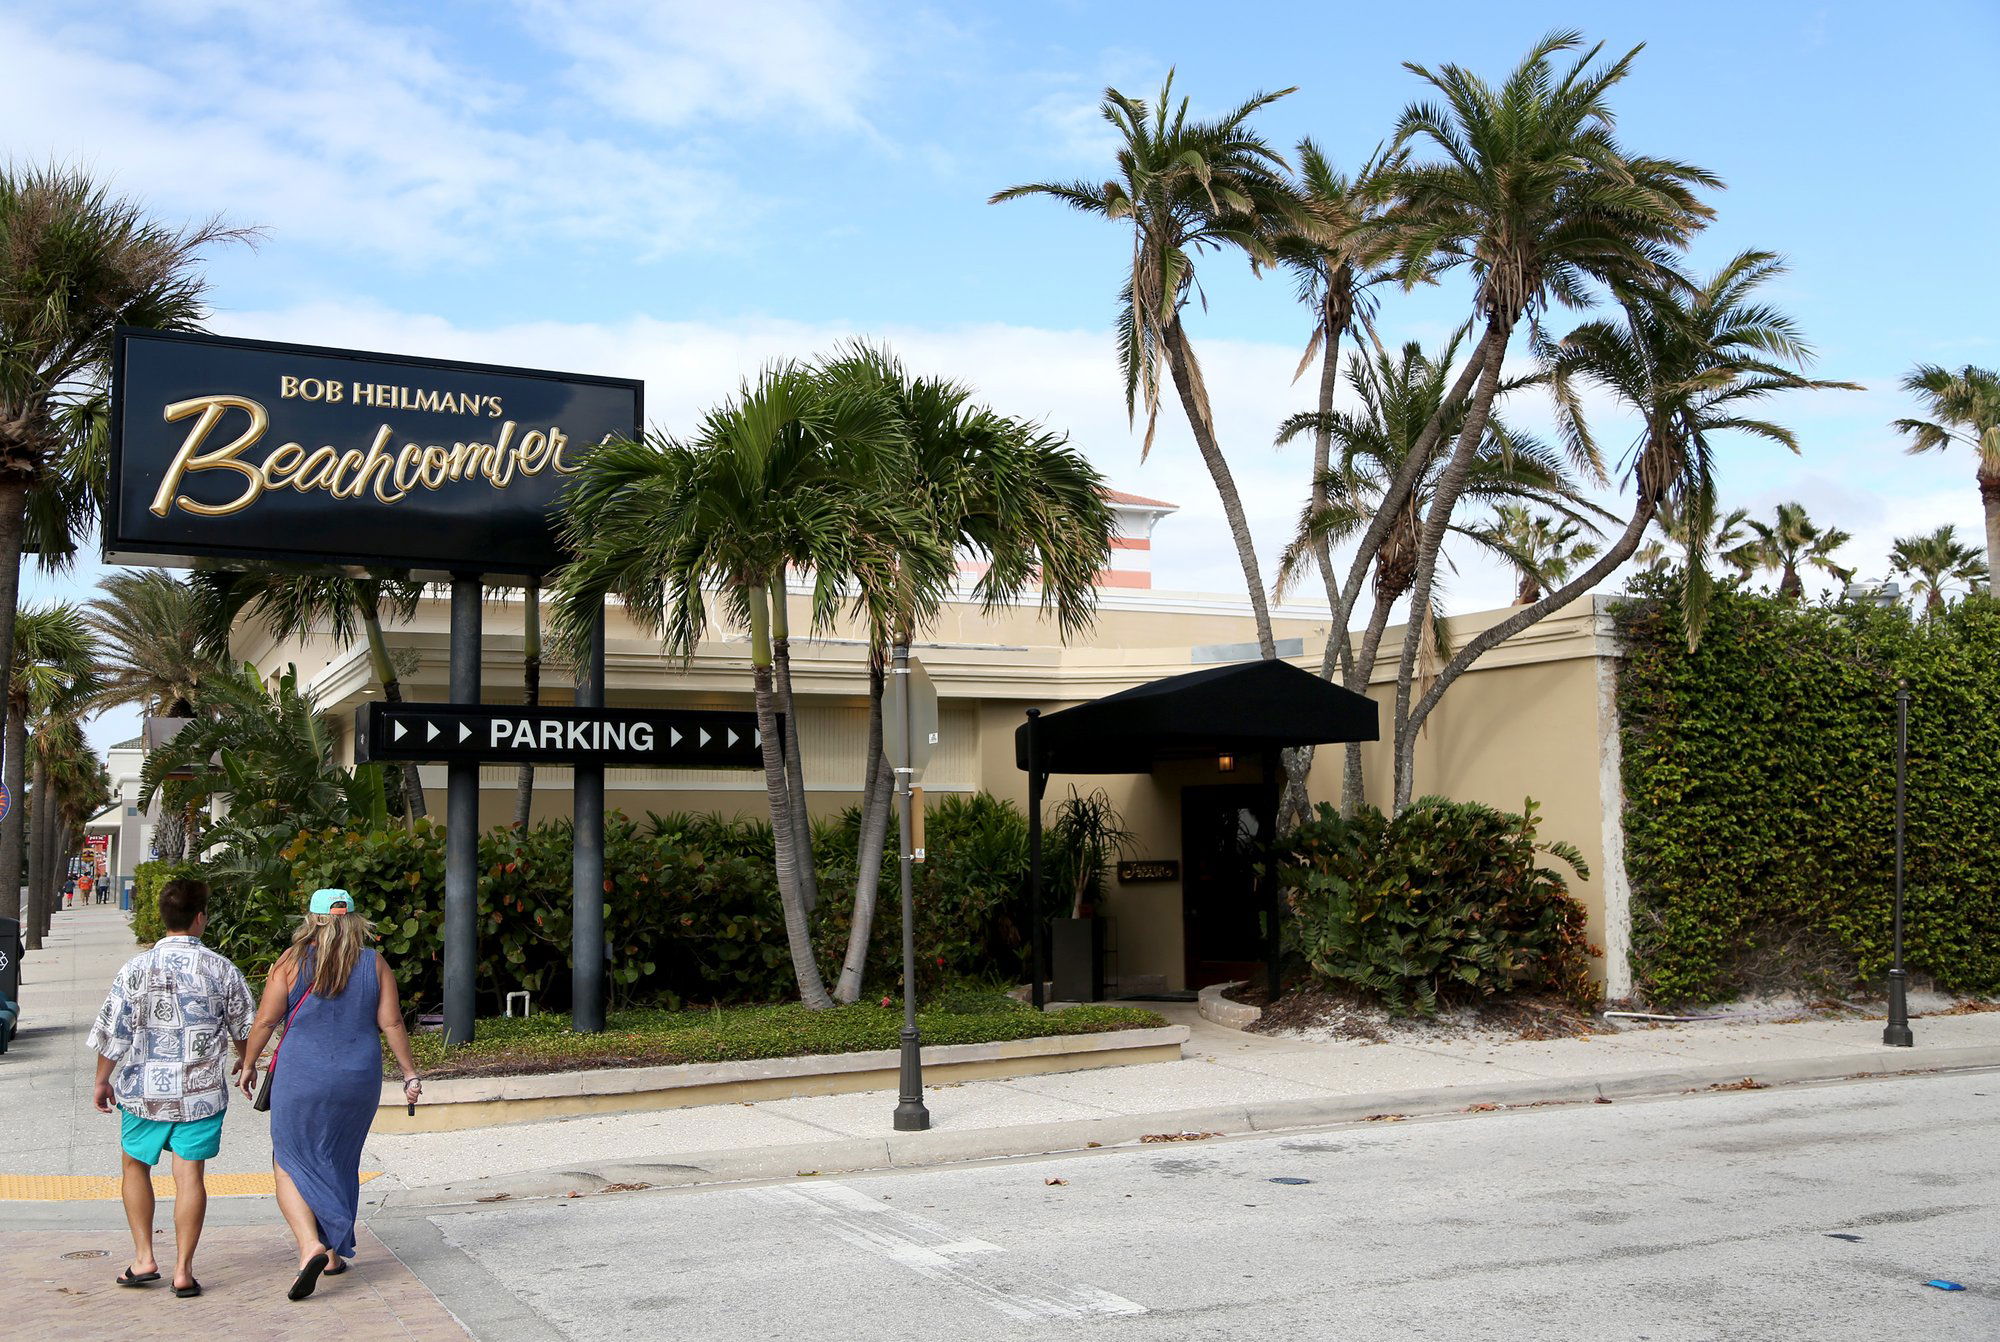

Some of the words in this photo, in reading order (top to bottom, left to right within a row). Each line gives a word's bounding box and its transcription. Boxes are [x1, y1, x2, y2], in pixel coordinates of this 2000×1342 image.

[280, 375, 344, 404] BOB
[352, 382, 504, 417] HEILMAN'S
[149, 394, 587, 517] Beachcomber
[490, 718, 654, 751] PARKING
